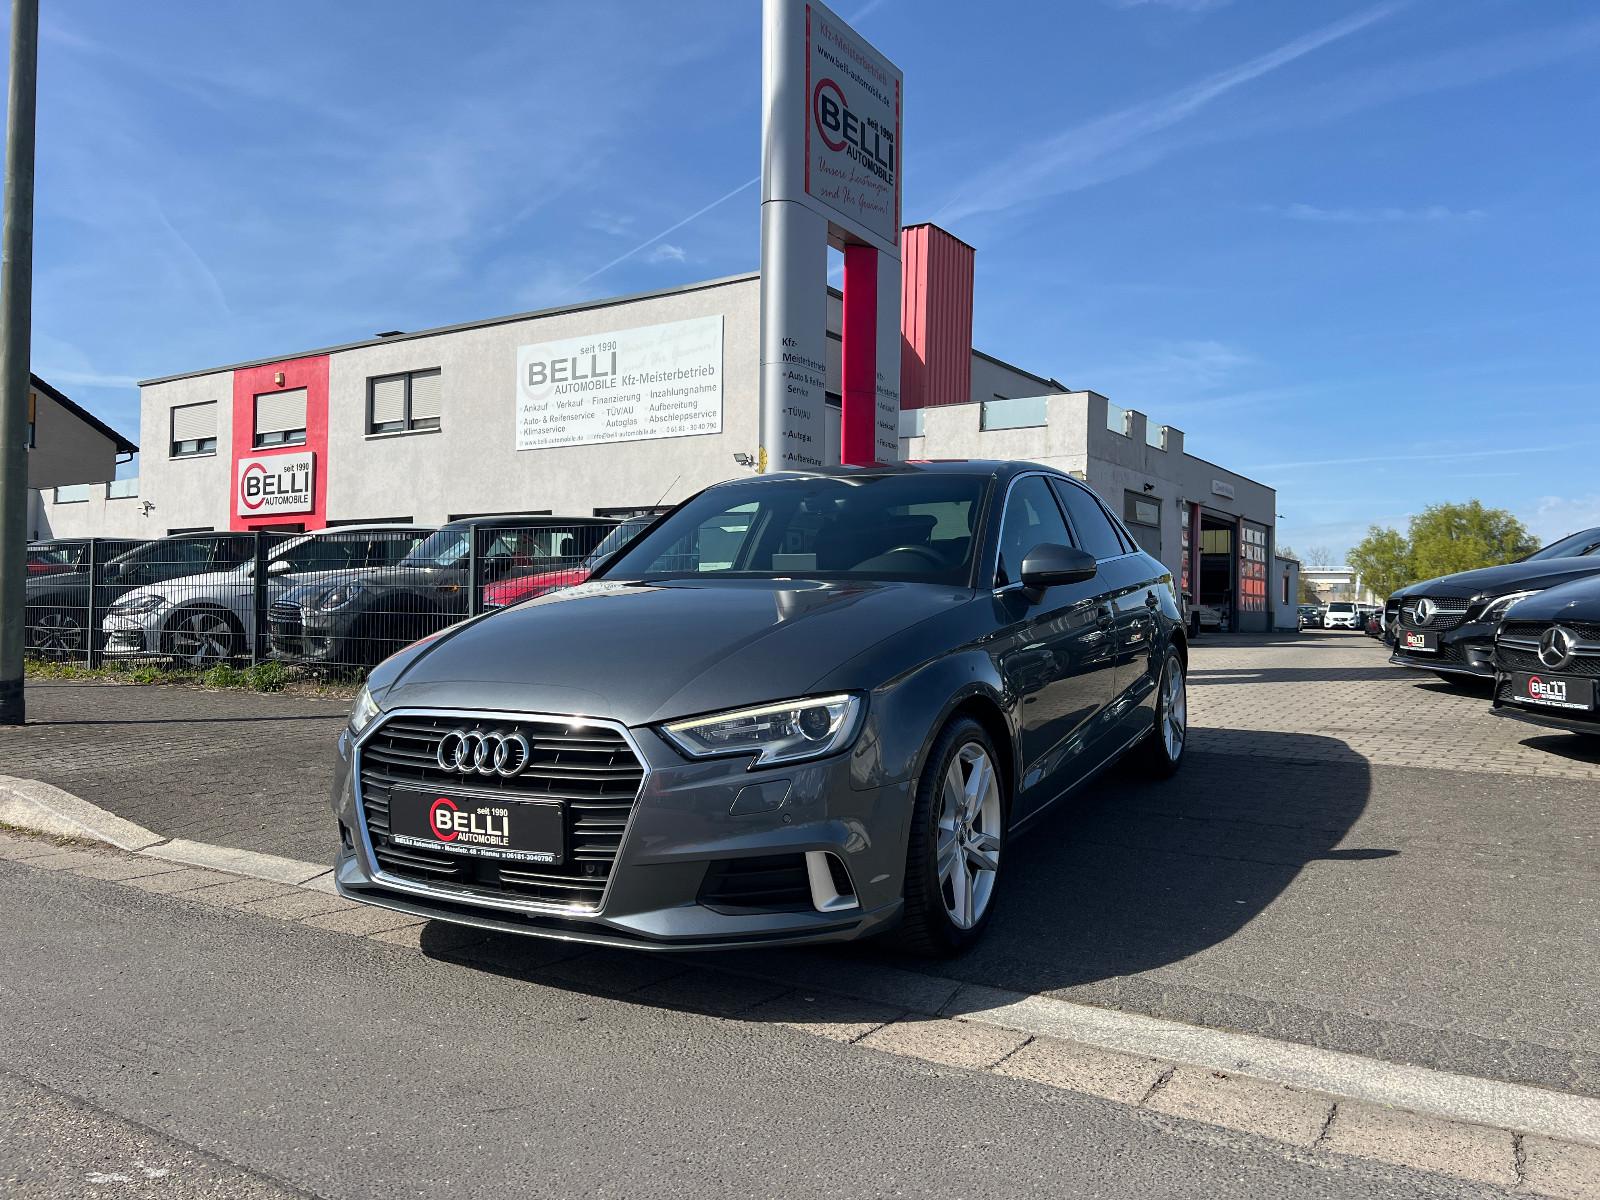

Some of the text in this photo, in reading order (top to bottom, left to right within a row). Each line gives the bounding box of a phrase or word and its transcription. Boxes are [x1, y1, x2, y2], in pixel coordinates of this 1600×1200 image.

[822, 94, 894, 172] BELLI
[867, 117, 894, 142] seit 1990
[847, 146, 894, 186] AUTOMOBILE
[580, 341, 616, 354] seit 1990
[782, 338, 798, 347] Kfz-
[528, 352, 616, 386] BELLI
[782, 353, 826, 372] Meisterbetrieb
[622, 364, 714, 386] Kfz-Meisterbetrieb
[788, 371, 802, 382] Auto
[555, 378, 616, 394] AUTOMOBILE
[524, 384, 716, 412] Ankauf Verkauf Finanzierung Inzahlungnahme
[550, 412, 595, 423] Reifenservice
[606, 406, 634, 416] TÜV/AU
[650, 400, 698, 412] Aufbereitung
[524, 410, 716, 436] Klimaservice Autoglas Abschleppservice
[296, 462, 309, 472] 1990
[246, 472, 308, 496] BELLI
[265, 495, 308, 506] AUTOMOBILE
[1532, 682, 1566, 696] BELLI
[492, 808, 508, 816] 1990
[436, 810, 509, 836] BELLI
[458, 832, 509, 846] AUTOMOBILE
[481, 850, 500, 858] Hanau
